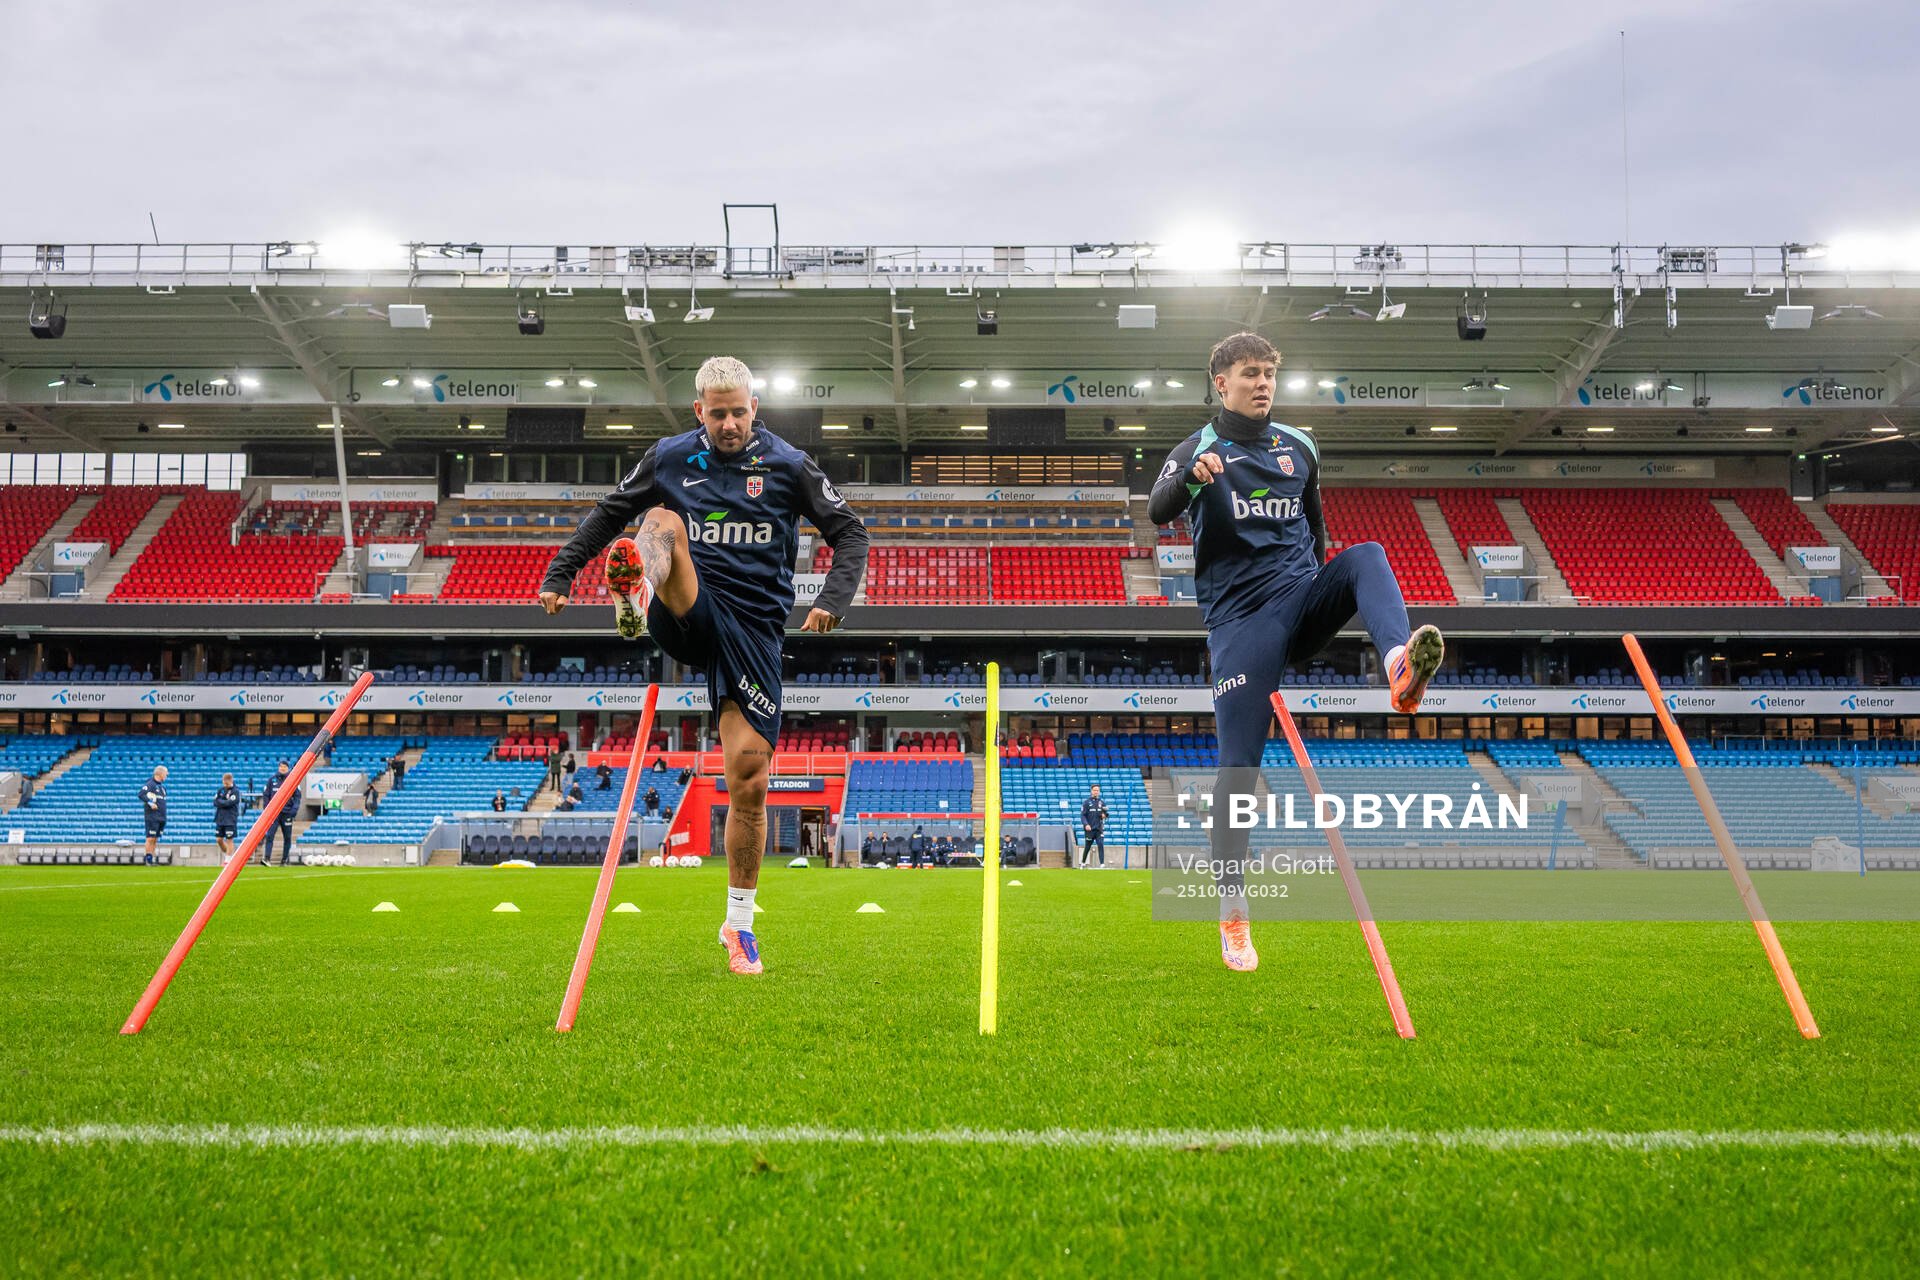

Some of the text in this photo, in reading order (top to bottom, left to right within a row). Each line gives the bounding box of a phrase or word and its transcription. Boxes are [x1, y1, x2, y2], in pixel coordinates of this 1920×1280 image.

[448, 380, 518, 397] telenor
[1078, 381, 1144, 398] teleno
[1350, 382, 1418, 399] telenor
[1481, 463, 1516, 473] telenor
[1567, 463, 1602, 473] telenor
[306, 488, 341, 498] telenor
[382, 488, 419, 498] telenor
[491, 489, 527, 498] telenor
[920, 490, 955, 500] telenor
[1000, 490, 1035, 500] telenor
[1080, 491, 1115, 500] telenor
[1231, 491, 1303, 520] bama
[686, 512, 772, 545] bama
[1489, 553, 1519, 562] telenor
[1806, 554, 1836, 562] telenor
[68, 691, 105, 701] telenor
[157, 692, 195, 702] telenor
[246, 692, 284, 702] telenor
[425, 692, 463, 702] telenor
[514, 692, 552, 702] telenor
[603, 692, 641, 703] telenor
[738, 674, 777, 715] bama
[783, 693, 820, 703] telenor
[871, 693, 909, 703] telenor
[960, 694, 987, 704] telen
[1050, 693, 1088, 704] telenor
[1139, 693, 1177, 704] telenor
[1318, 694, 1357, 704] telenor
[1498, 694, 1536, 705] telenor
[1587, 694, 1625, 705] telenor
[1677, 694, 1715, 705] telenor
[1767, 694, 1805, 705] telenor
[1856, 694, 1894, 705] telenor
[1422, 697, 1447, 705] enor
[773, 780, 810, 789] STADION
